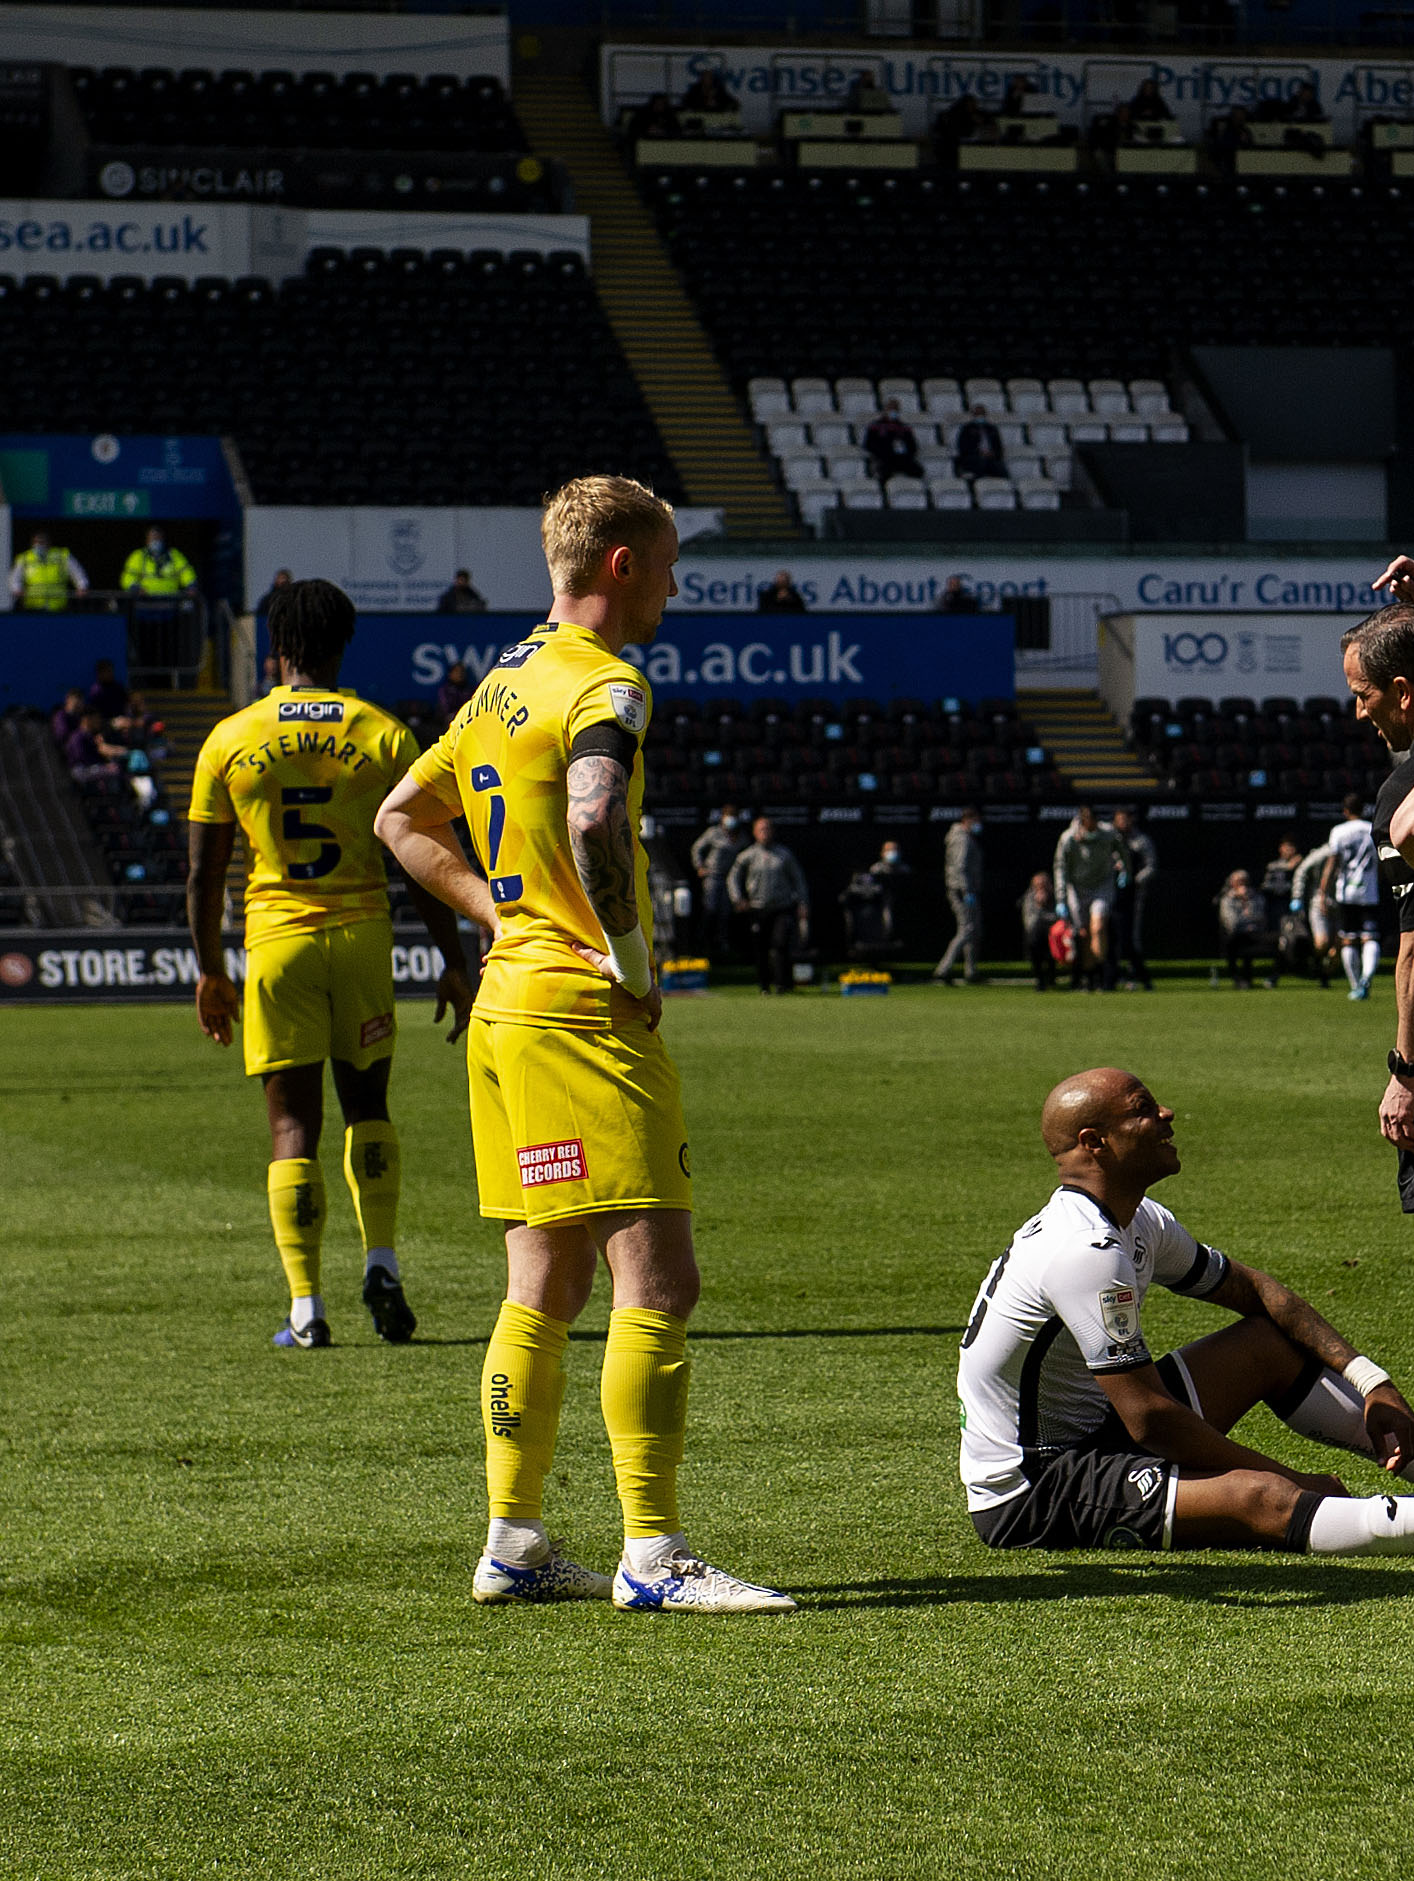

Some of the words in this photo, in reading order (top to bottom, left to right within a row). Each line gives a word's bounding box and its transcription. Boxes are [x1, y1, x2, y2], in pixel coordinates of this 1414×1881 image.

[830, 574, 939, 604] About
[1138, 574, 1244, 605] Caru'r
[280, 702, 343, 719] origin
[248, 731, 373, 774] STEWART
[281, 786, 342, 880] 5
[518, 1147, 555, 1166] CHERRY
[557, 1143, 579, 1160] RED
[521, 1159, 582, 1185] RECORDS
[1102, 1294, 1116, 1305] sky
[490, 1373, 521, 1437] o'neills
